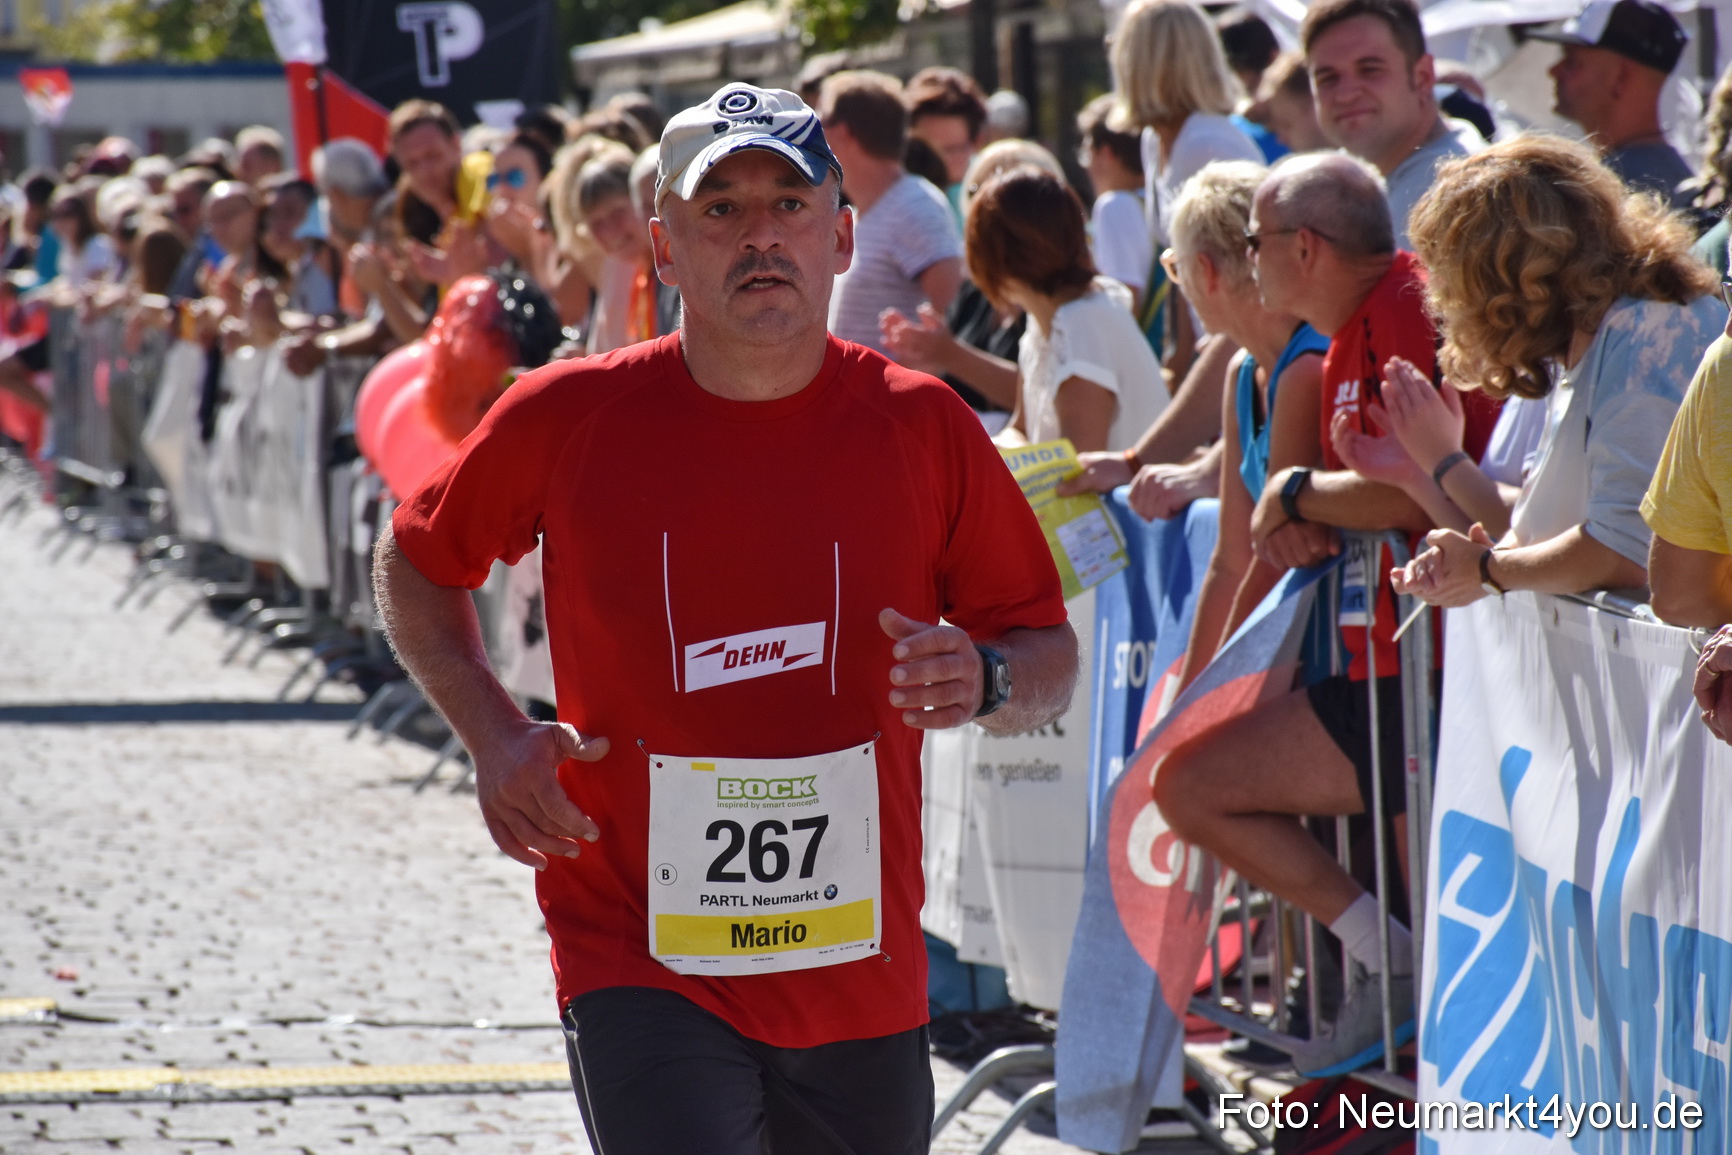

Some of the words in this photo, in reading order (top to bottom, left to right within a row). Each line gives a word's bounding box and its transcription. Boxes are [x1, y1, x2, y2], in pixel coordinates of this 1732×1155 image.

[722, 639, 787, 671] DEHN
[716, 774, 818, 801] BOCK
[717, 800, 749, 810] inspired
[751, 801, 760, 811] by
[762, 800, 786, 809] smart
[787, 797, 820, 809] concepts
[705, 814, 830, 884] 267
[661, 868, 671, 881] B
[700, 894, 749, 907] PARTL
[752, 890, 819, 907] Neumarkt
[730, 919, 808, 949] Mario
